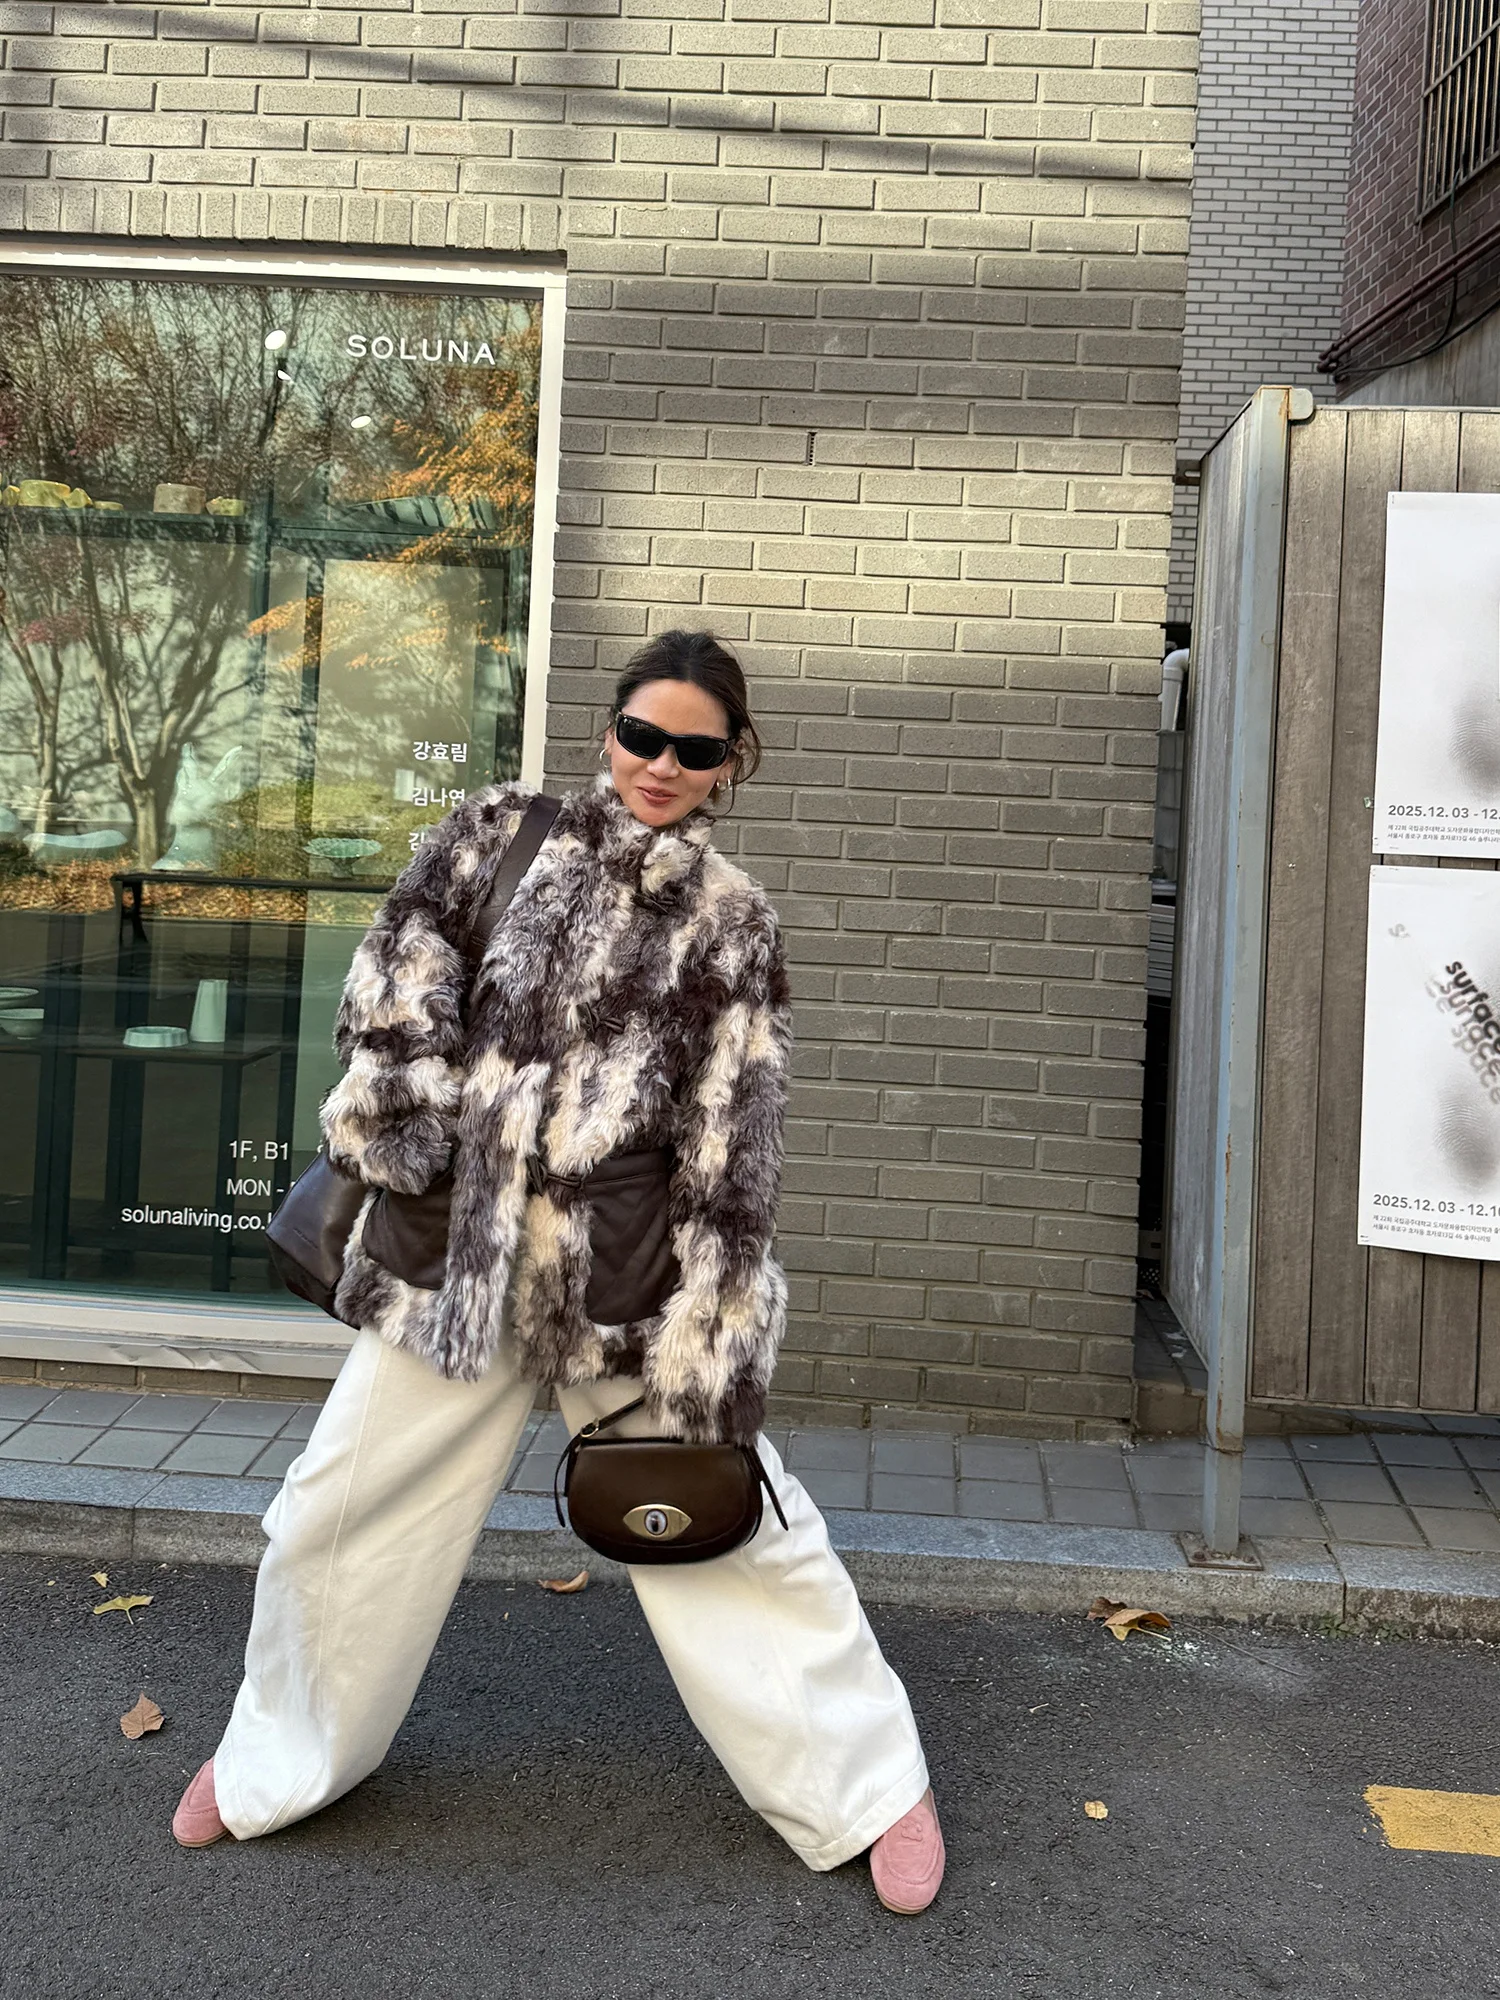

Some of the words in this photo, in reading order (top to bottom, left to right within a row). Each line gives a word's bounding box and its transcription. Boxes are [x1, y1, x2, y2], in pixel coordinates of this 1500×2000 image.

[346, 334, 496, 366] SOLUNA
[412, 740, 467, 763] 강효림
[411, 787, 465, 808] 김나연
[229, 1140, 257, 1162] 1F,
[264, 1141, 289, 1161] B1
[226, 1178, 272, 1197] MON
